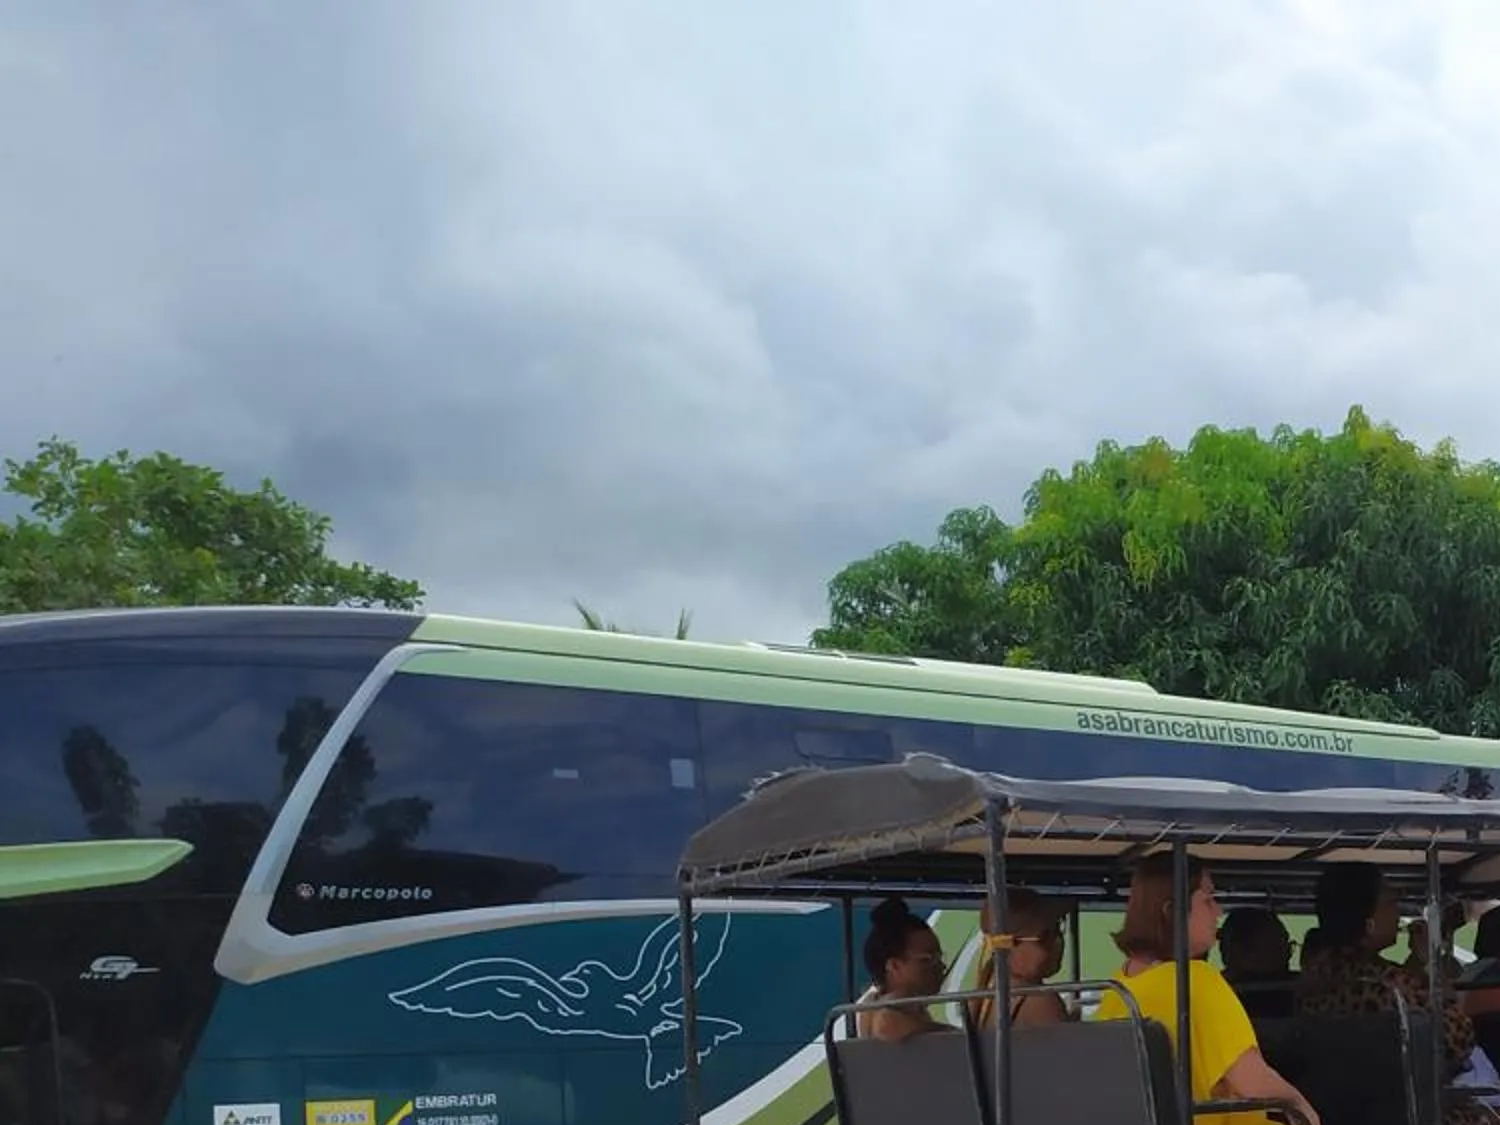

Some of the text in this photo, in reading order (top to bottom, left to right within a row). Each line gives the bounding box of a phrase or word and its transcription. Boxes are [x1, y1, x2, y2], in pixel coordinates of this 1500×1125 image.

[1077, 710, 1353, 752] asabrancaturismo.com.br
[319, 884, 433, 901] Marcopolo
[415, 1094, 496, 1109] EMBRATUR
